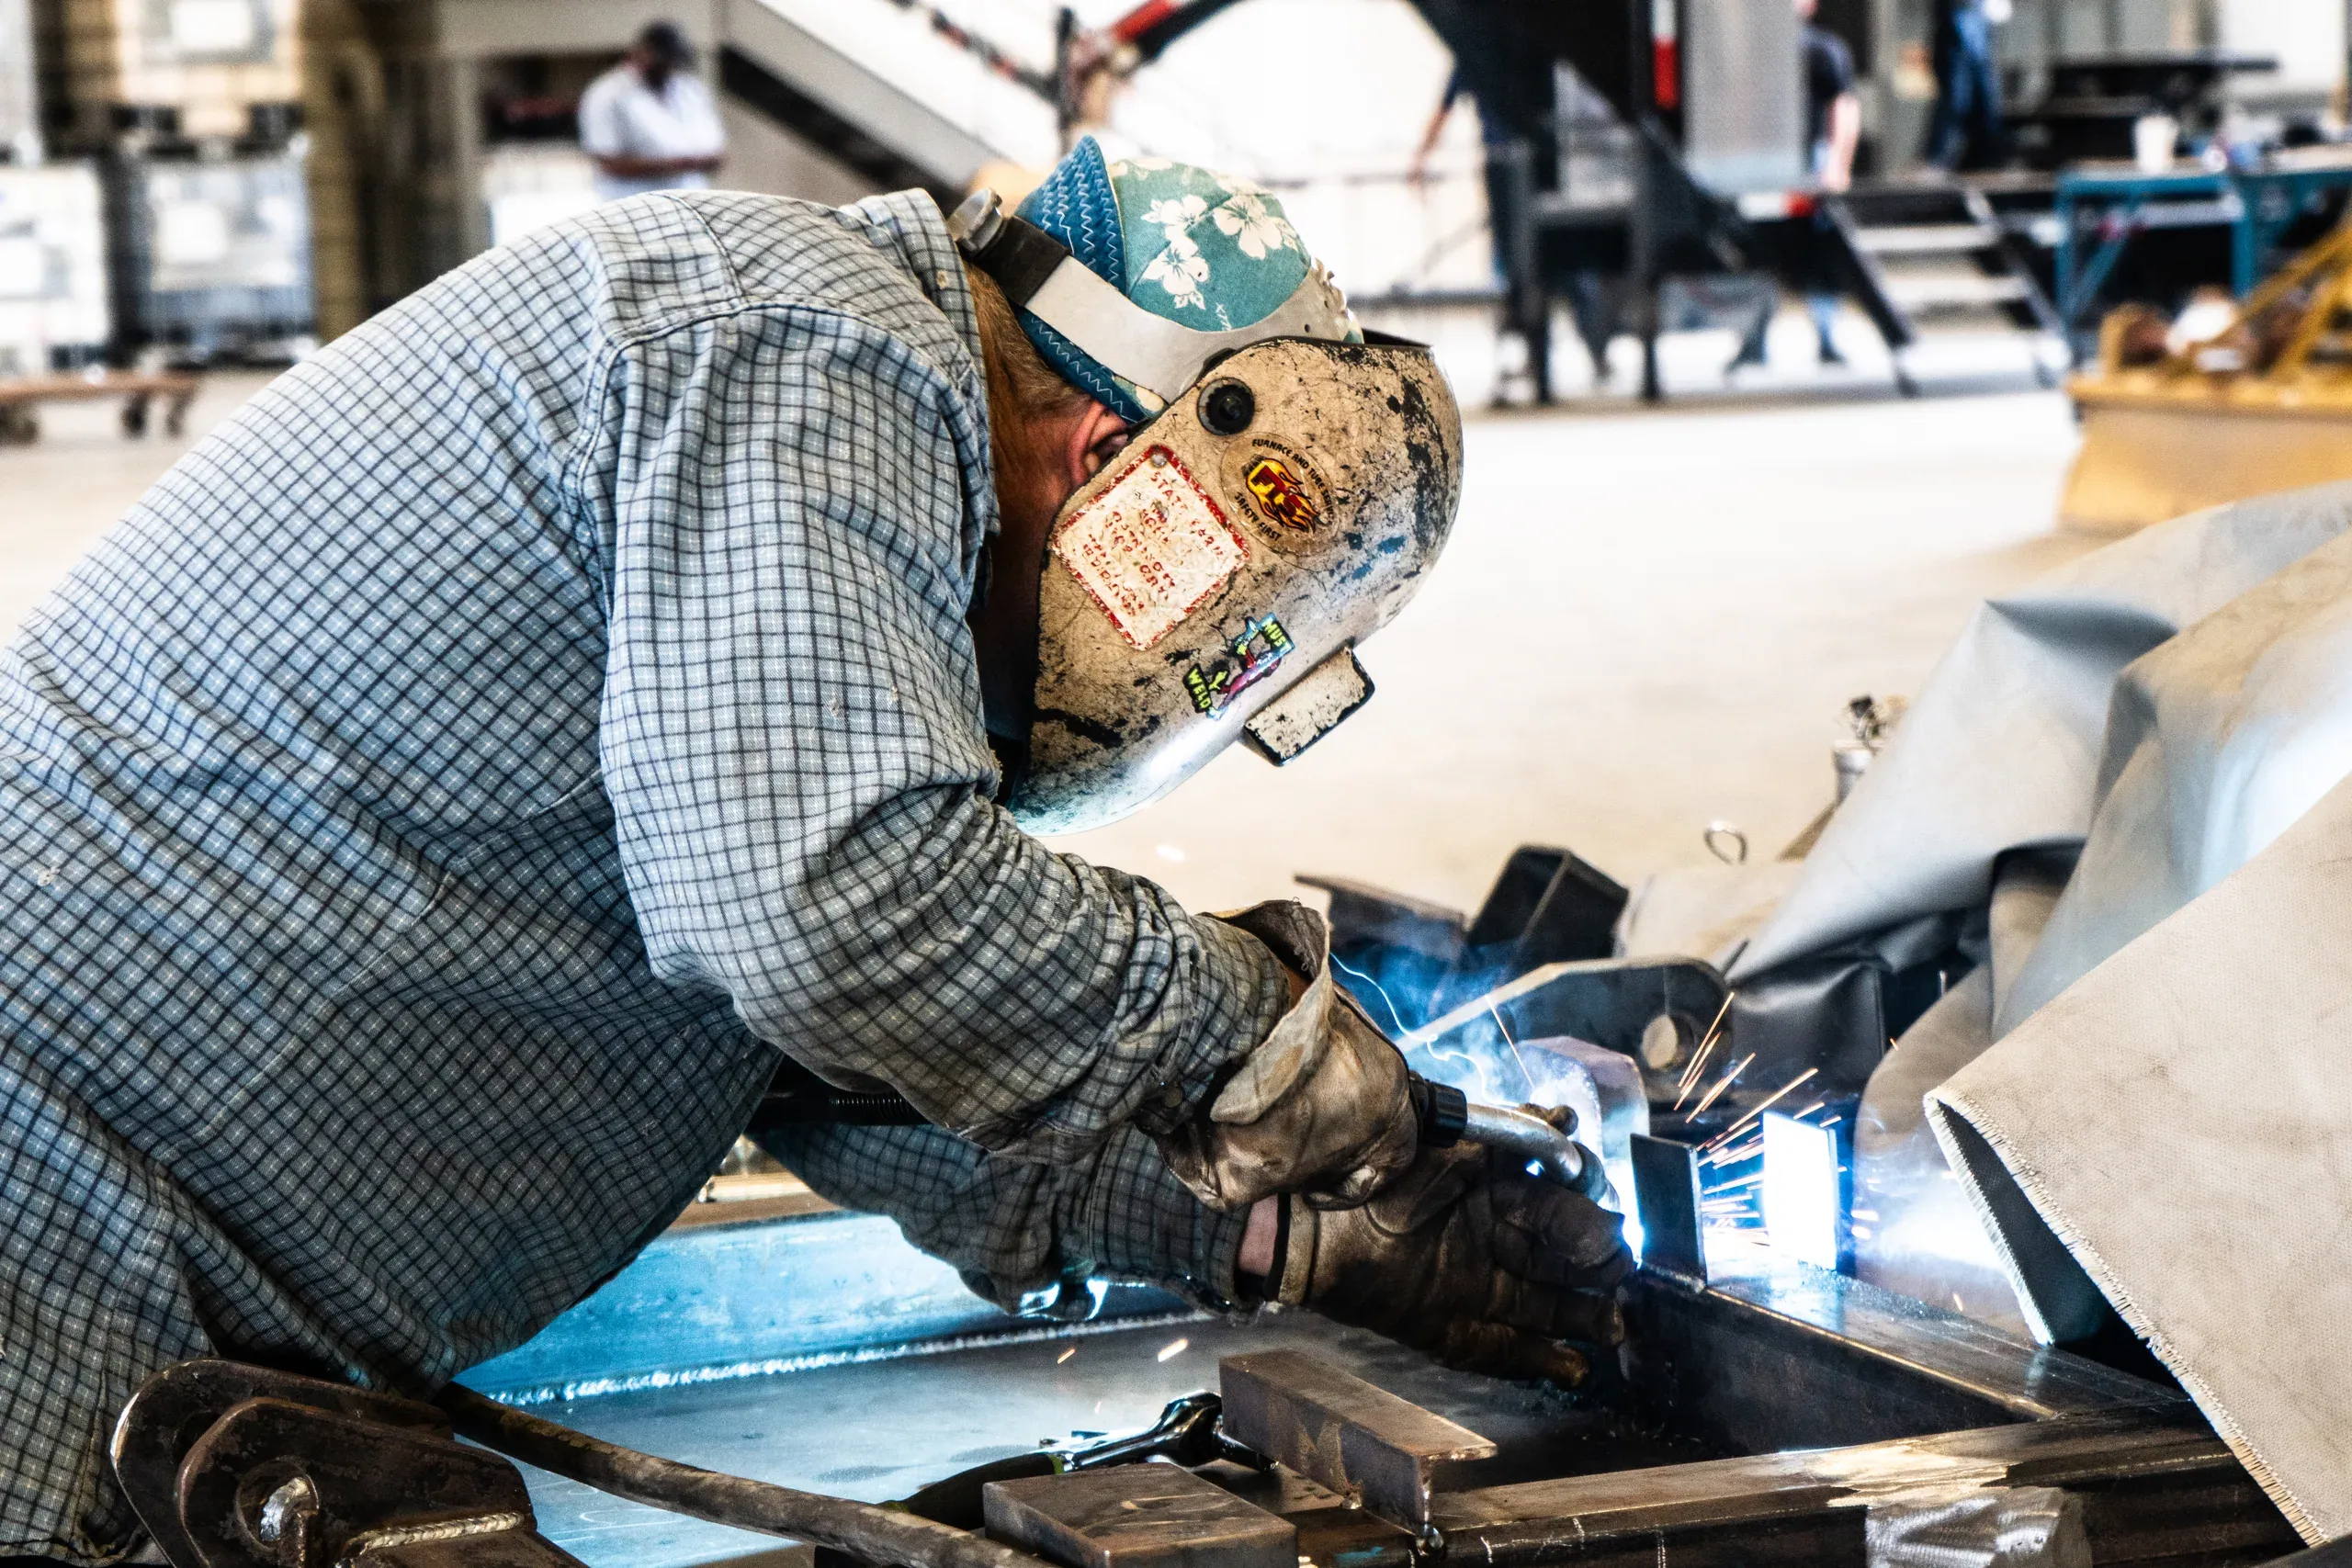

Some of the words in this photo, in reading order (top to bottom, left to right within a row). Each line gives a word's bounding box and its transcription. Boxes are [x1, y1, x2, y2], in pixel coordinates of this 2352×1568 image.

[1250, 465, 1303, 517] FTS
[1252, 438, 1292, 457] FURNACE
[1291, 454, 1309, 469] AND
[1308, 468, 1326, 489] TUBE
[1321, 489, 1334, 524] SERVI
[1235, 491, 1260, 524] SAFETY
[1259, 522, 1282, 541] FIRST
[1261, 618, 1292, 653] MUST
[1188, 668, 1212, 709] WELD
